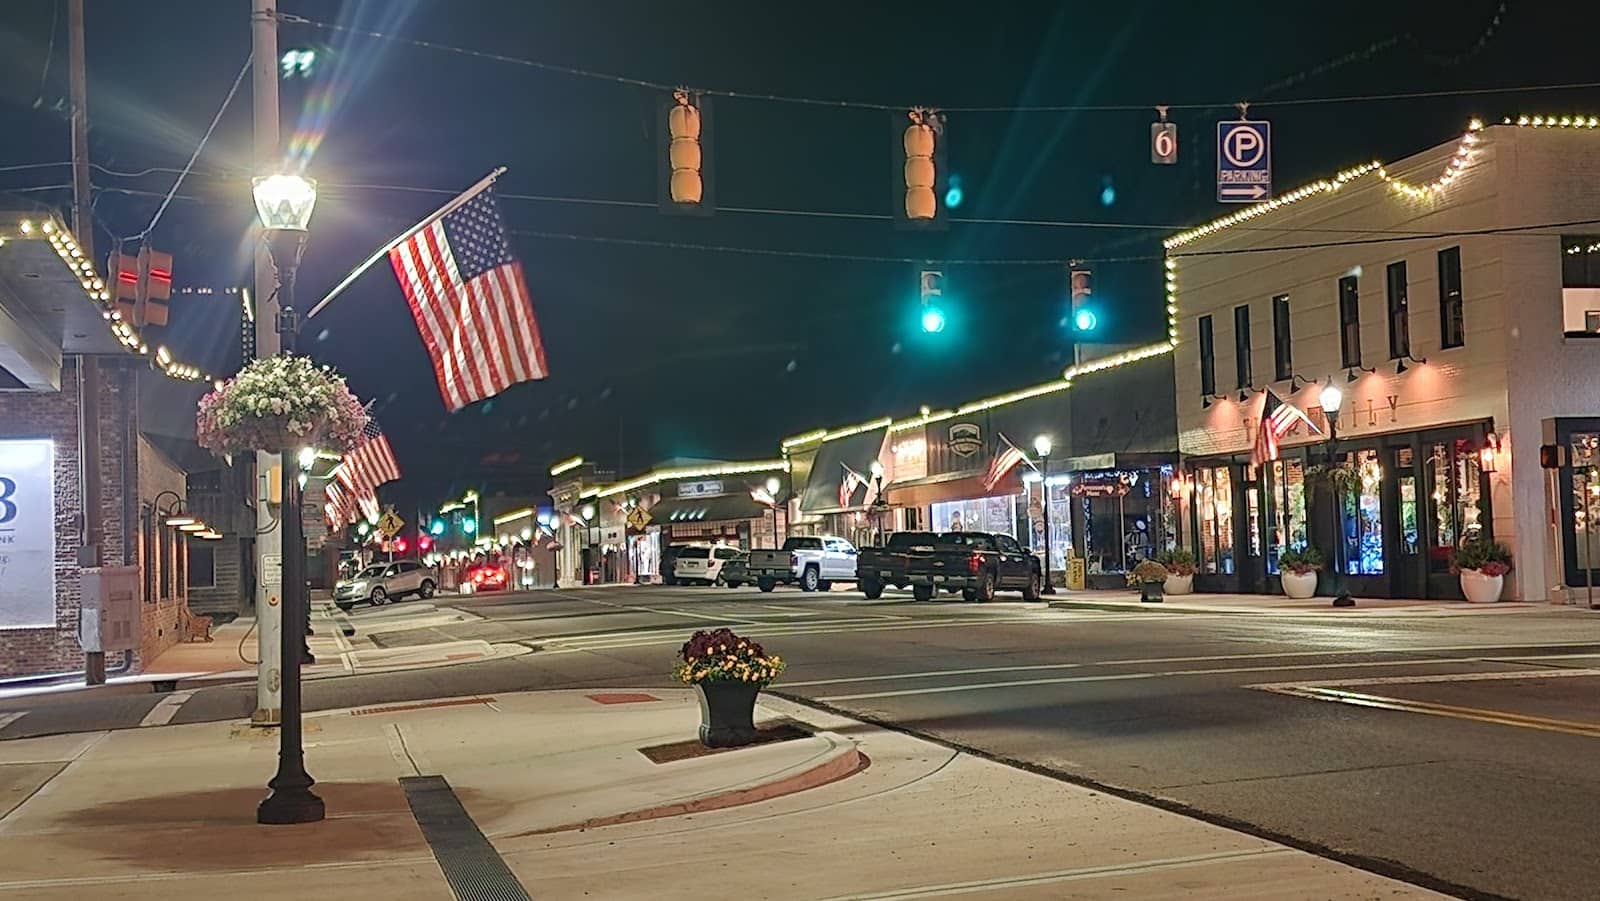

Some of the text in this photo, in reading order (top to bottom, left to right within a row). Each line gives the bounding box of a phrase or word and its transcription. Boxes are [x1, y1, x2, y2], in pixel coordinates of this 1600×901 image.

[1155, 130, 1173, 157] 6
[1235, 132, 1258, 161] P
[1220, 169, 1269, 182] PARKING
